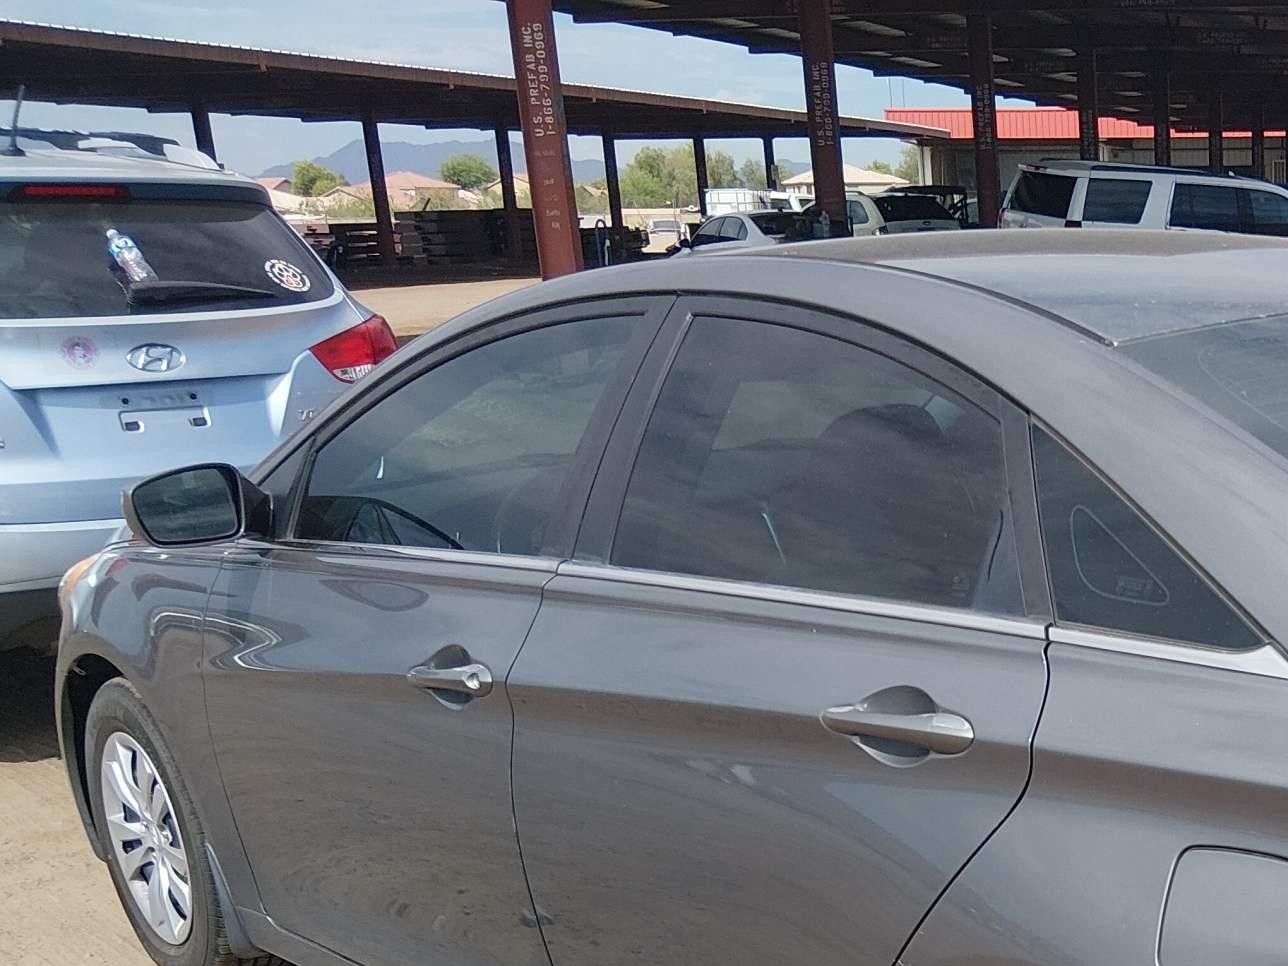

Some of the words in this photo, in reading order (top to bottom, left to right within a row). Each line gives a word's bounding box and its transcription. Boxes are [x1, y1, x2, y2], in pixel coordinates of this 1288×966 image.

[521, 22, 533, 48] INC.
[526, 54, 541, 105] PREFAB
[532, 23, 556, 135] 1-866-799-0969
[533, 112, 545, 137] U.S.
